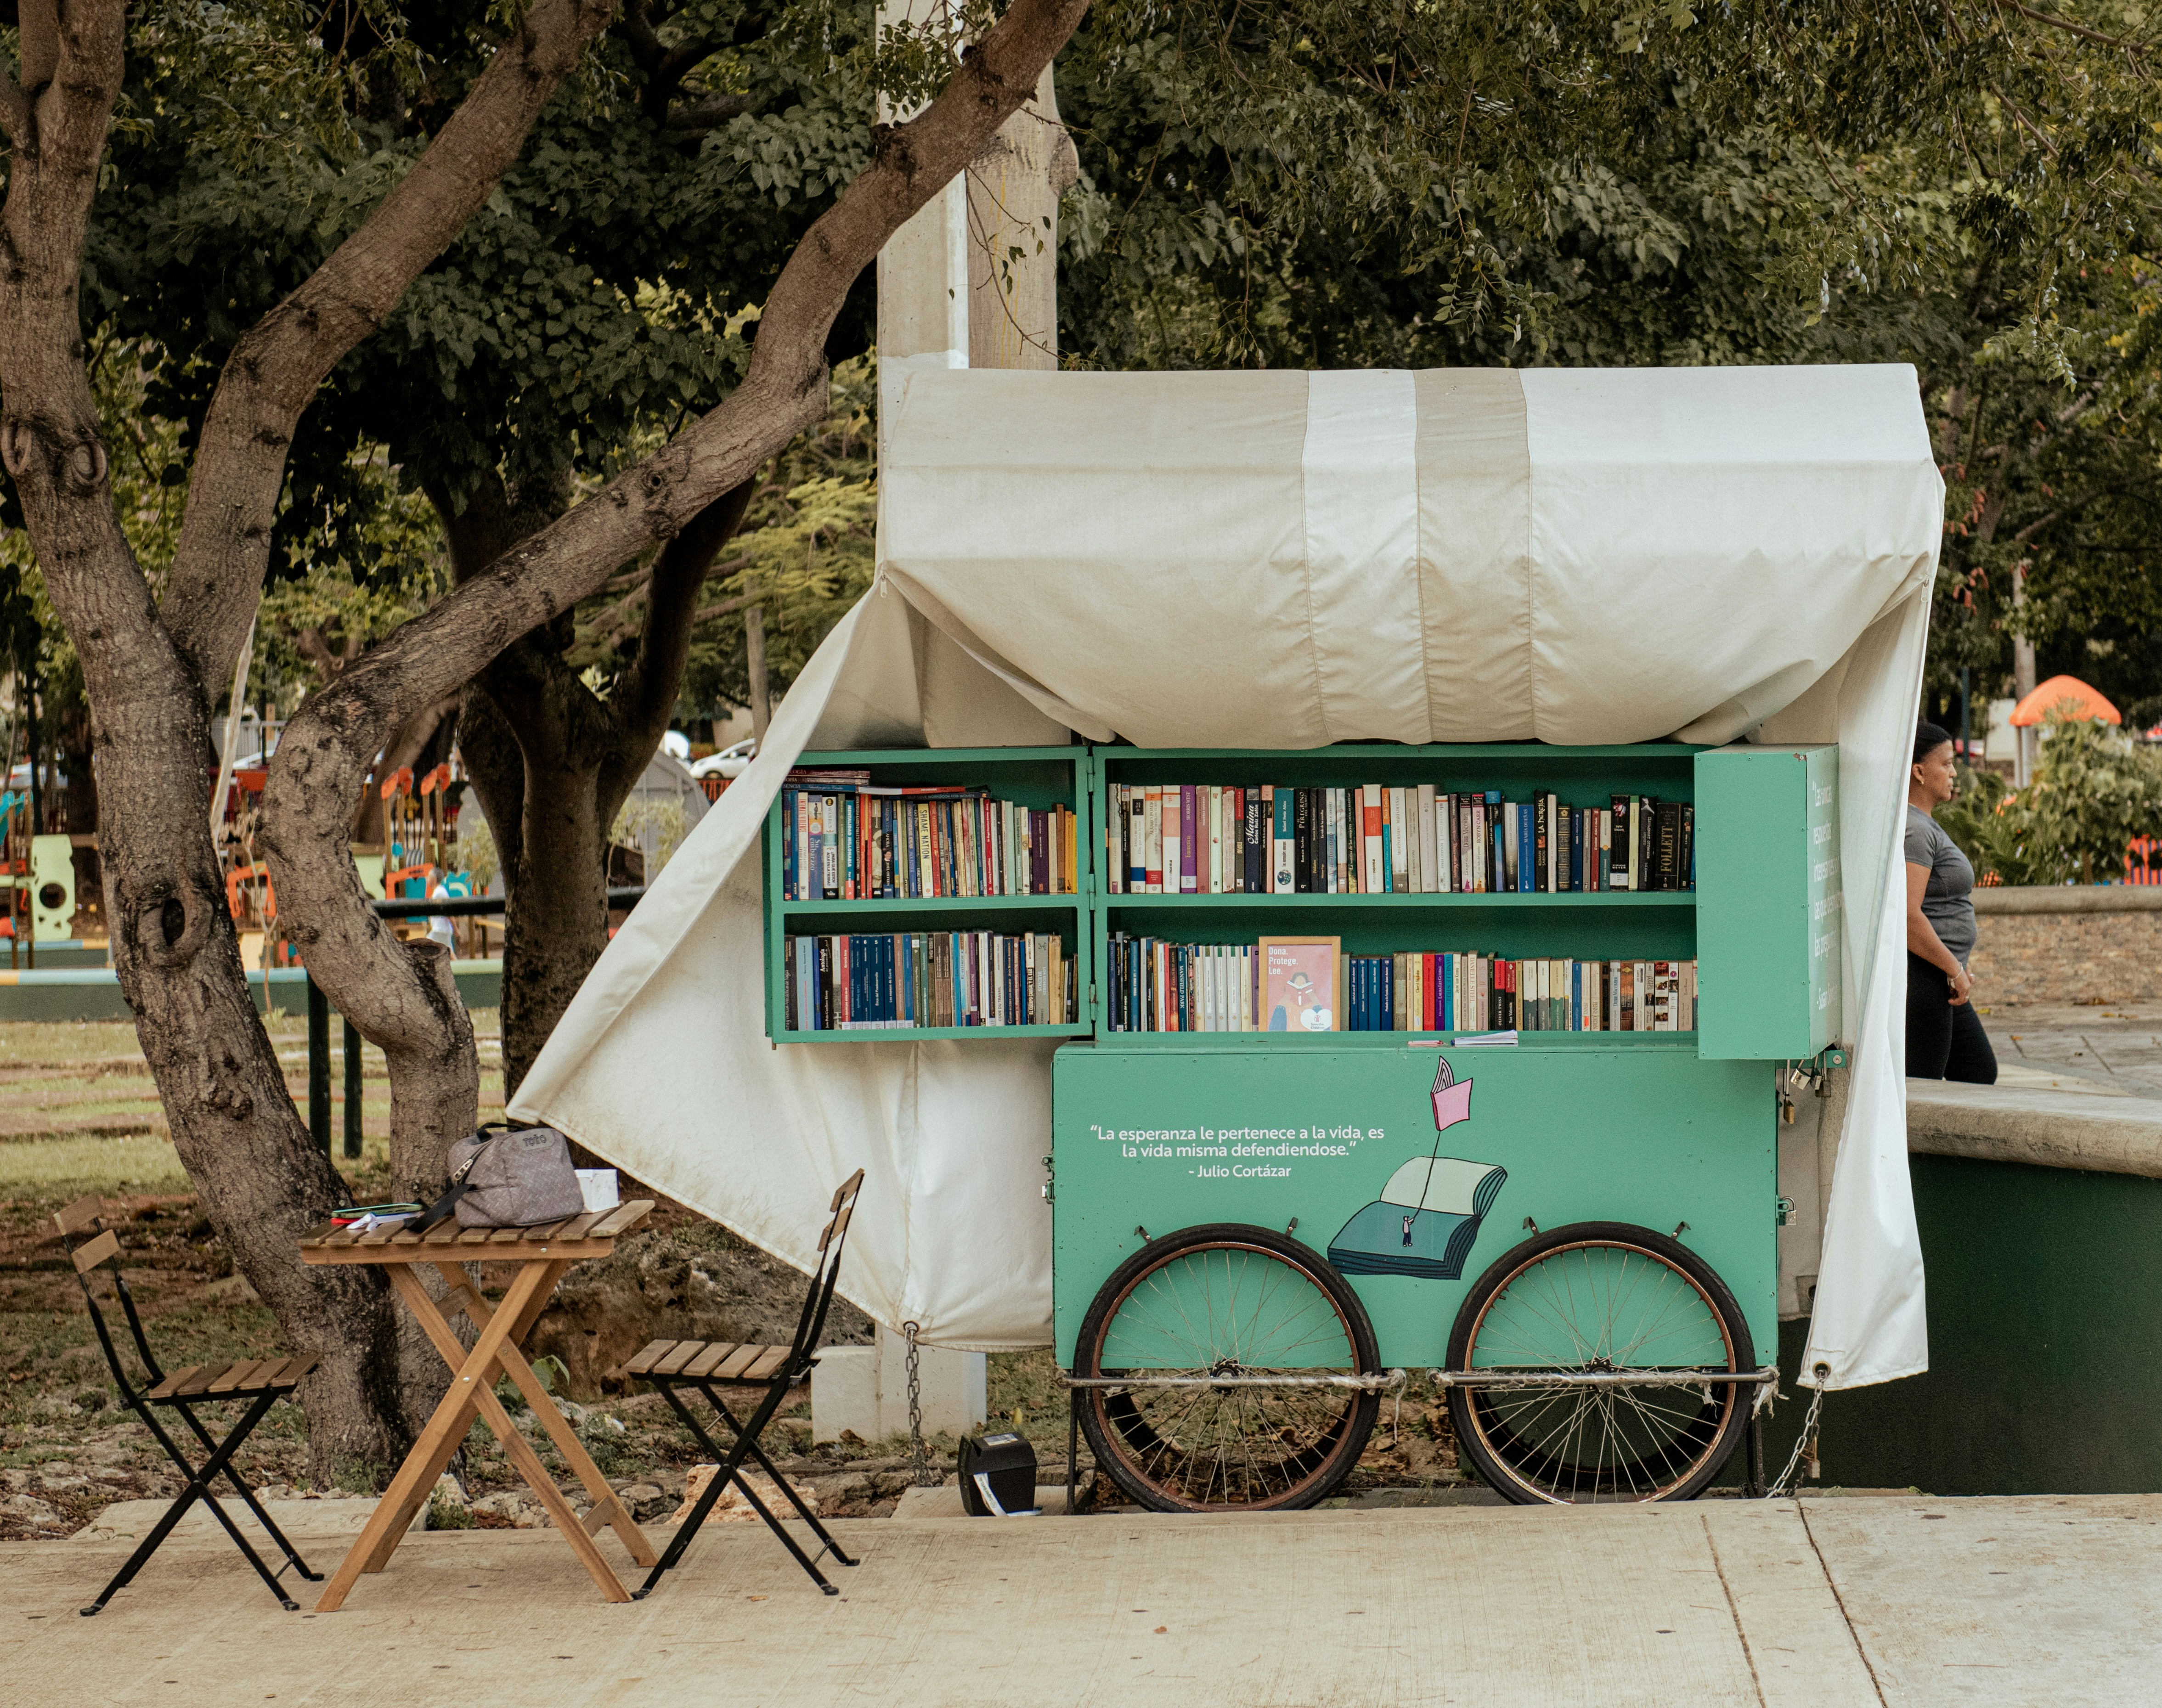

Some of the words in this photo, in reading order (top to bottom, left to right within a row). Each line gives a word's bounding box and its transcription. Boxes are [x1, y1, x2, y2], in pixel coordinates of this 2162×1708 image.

[920, 810, 928, 833] SHAME
[1245, 804, 1255, 844] Marina
[814, 839, 821, 847] Su
[1813, 819, 1832, 850] respuestas
[921, 835, 930, 859] NATION
[1660, 826, 1673, 872] FOLLETT
[1269, 957, 1298, 966] Protege.
[1819, 988, 1828, 1011] Susan
[1090, 1124, 1115, 1140] “La
[1118, 1128, 1196, 1144] esperanza
[1200, 1126, 1214, 1140] le
[1218, 1128, 1296, 1143] pertenece
[1299, 1129, 1309, 1139] a
[1312, 1126, 1326, 1139] la
[1329, 1125, 1364, 1141] vida,
[1368, 1128, 1384, 1139] es
[1122, 1144, 1137, 1157] la
[1140, 1143, 1173, 1157] vida
[1176, 1144, 1227, 1157] misma
[1231, 1141, 1356, 1156] defendiendose.”
[1197, 1165, 1229, 1177] Julio
[1232, 1164, 1291, 1177] Cortázar
